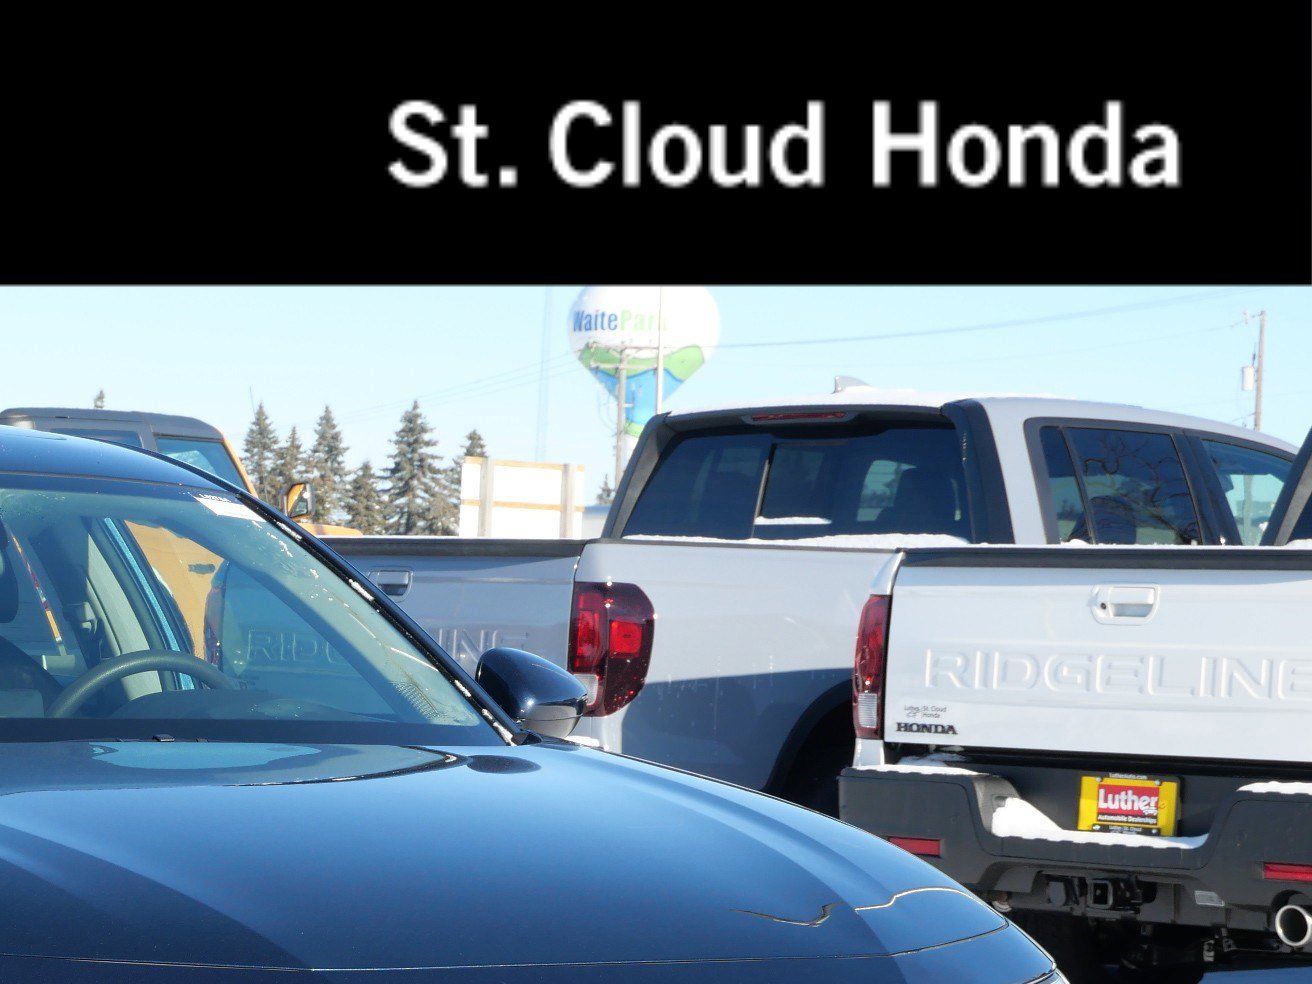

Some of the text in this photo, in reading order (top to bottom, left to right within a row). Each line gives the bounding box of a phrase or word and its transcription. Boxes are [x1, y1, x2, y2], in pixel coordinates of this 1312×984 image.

[924, 648, 1312, 700] RIDGELINE
[896, 721, 959, 736] HONDA
[1098, 788, 1158, 810] Luther
